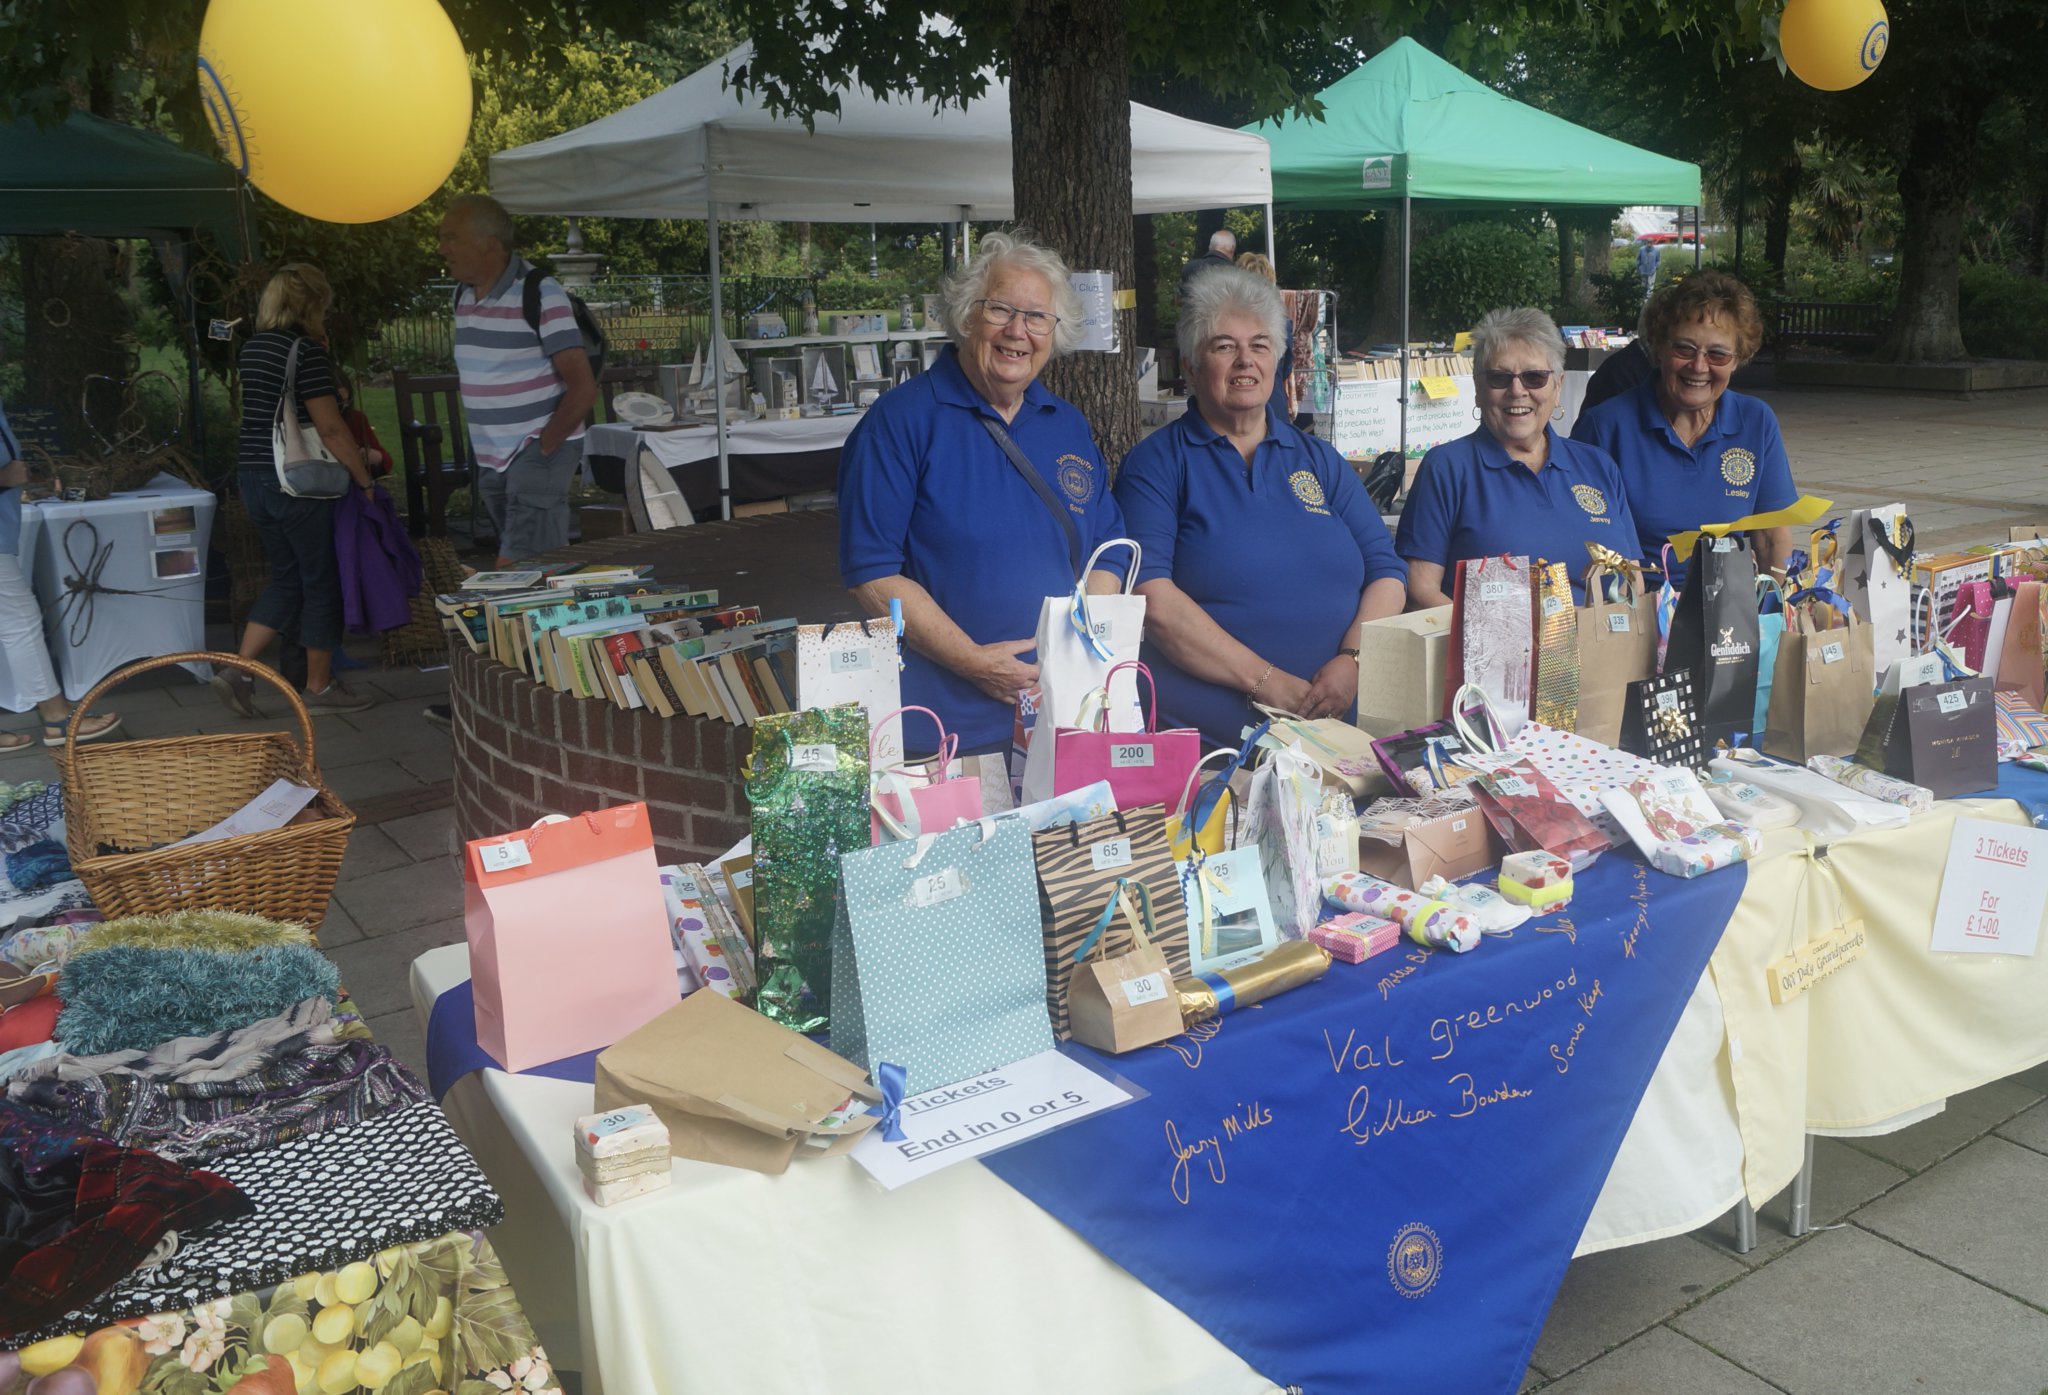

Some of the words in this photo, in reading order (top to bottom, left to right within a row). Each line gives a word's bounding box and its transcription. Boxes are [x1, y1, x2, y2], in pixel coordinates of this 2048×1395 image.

[610, 340, 636, 351] 1923
[651, 338, 677, 350] 2023
[1344, 419, 1372, 428] precious
[1725, 488, 1750, 499] Lesley
[1486, 584, 1503, 594] 380
[1613, 615, 1625, 625] 335
[1710, 641, 1751, 657] Glenfiddich
[841, 651, 858, 664] 85
[1921, 664, 1934, 675] 455
[1661, 692, 1674, 704] 390
[1943, 694, 1959, 705] 425
[801, 748, 820, 761] 45
[1119, 746, 1144, 759] 200
[1502, 779, 1520, 790] 310
[1667, 778, 1686, 790] 370
[498, 846, 509, 860] 5
[1103, 843, 1119, 857] 65
[1976, 837, 1984, 854] 3
[1987, 839, 2029, 863] Tickets
[1323, 857, 1344, 867] You
[681, 882, 696, 893] 50
[1471, 890, 1491, 902] 340
[1980, 890, 2000, 909] For
[1966, 914, 1975, 932] £
[1797, 962, 1815, 983] Duty
[1816, 931, 1865, 971] Grandparents
[899, 1076, 1007, 1114] Tickets
[1339, 1084, 1437, 1145] Gillian
[1448, 1072, 1533, 1118] Bowden
[603, 1113, 626, 1127] 30
[897, 1121, 962, 1159] End
[966, 1119, 998, 1137] in
[1000, 1110, 1021, 1125] 0
[1028, 1099, 1059, 1116] or
[1061, 1090, 1083, 1104] 5
[1222, 1100, 1274, 1142] Mills
